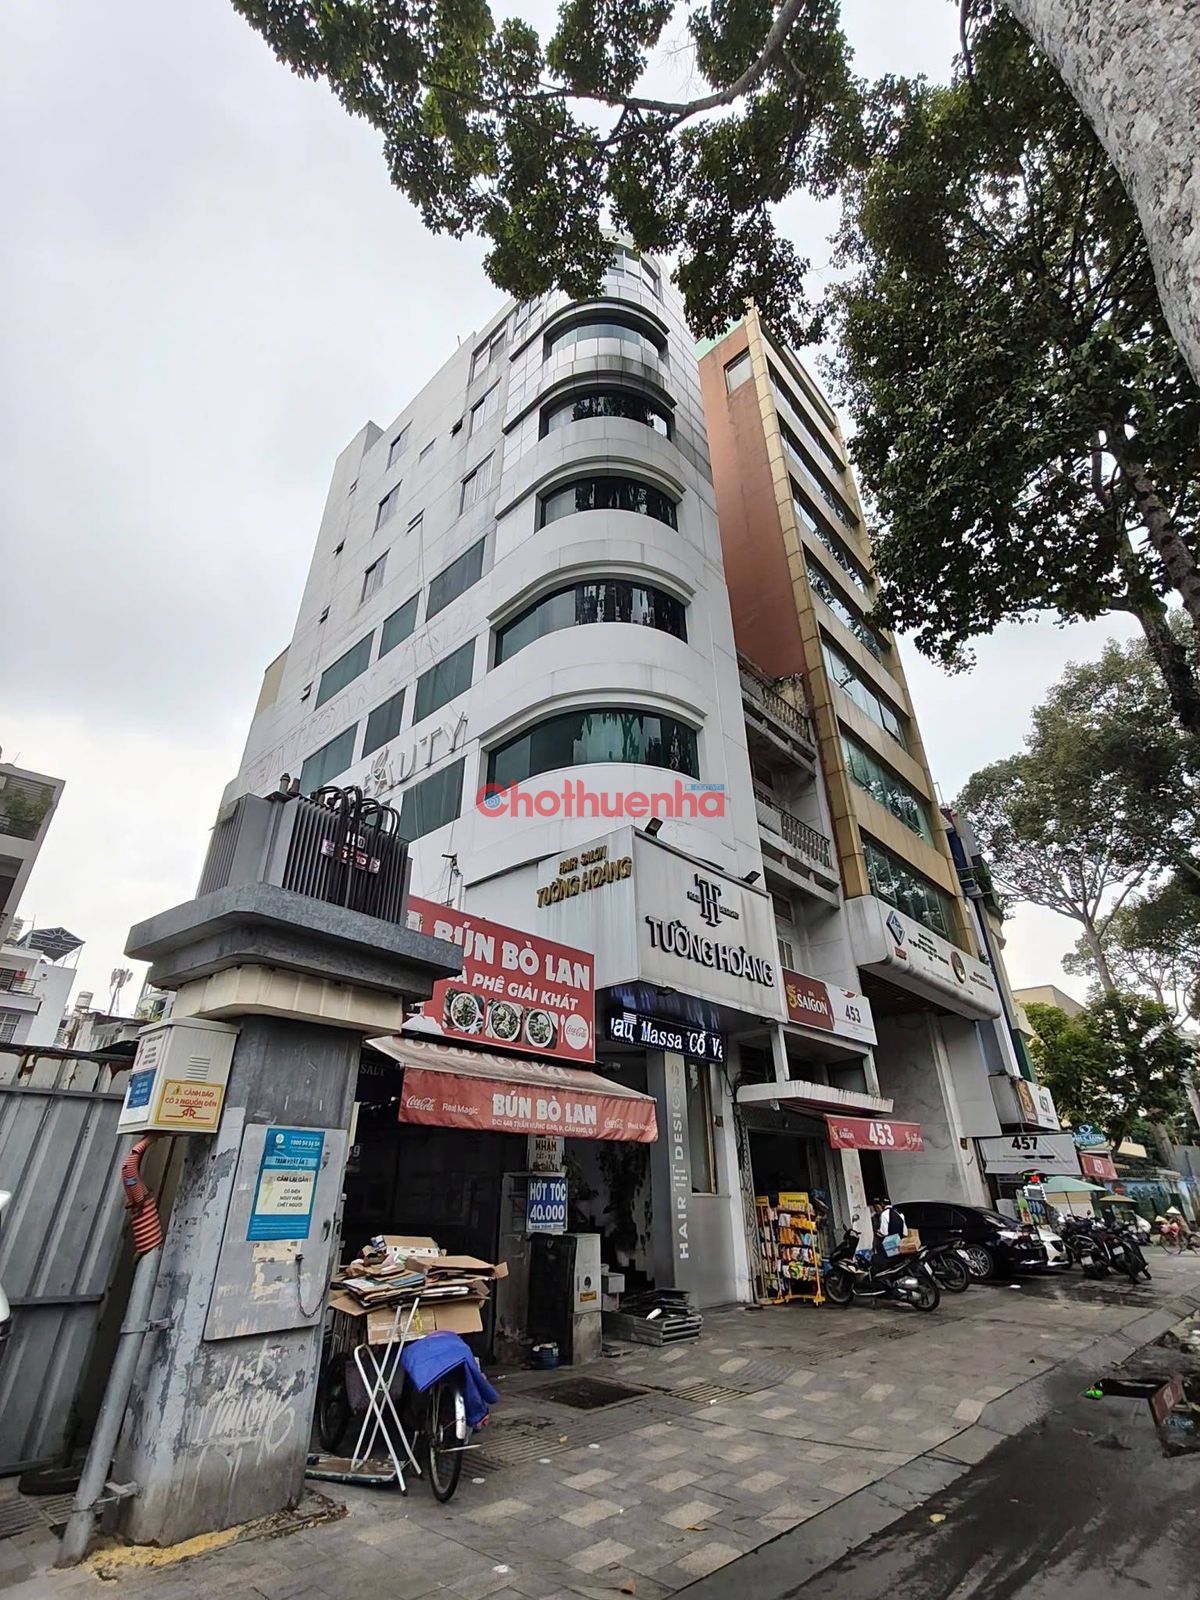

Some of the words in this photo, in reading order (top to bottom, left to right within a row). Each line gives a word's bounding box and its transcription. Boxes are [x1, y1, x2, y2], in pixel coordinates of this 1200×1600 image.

[581, 856, 632, 892] HOÀNG
[502, 940, 540, 976] BÒ
[545, 953, 590, 992] LAN
[645, 915, 714, 968] TƯỜNG
[714, 943, 774, 987] HOÀNG
[471, 972, 505, 993] PHÊ
[507, 981, 539, 1001] GIẢI
[540, 992, 579, 1011] KHÁT
[796, 993, 829, 1016] SAIGON
[845, 1004, 862, 1024] 453
[641, 1020, 683, 1050] Massa
[442, 1103, 456, 1112] Real
[492, 1090, 532, 1119] BÚN
[536, 1095, 562, 1122] BÒ
[565, 1103, 597, 1125] LAN
[869, 1122, 895, 1146] 453
[1011, 1136, 1038, 1151] 457
[530, 1180, 548, 1201] HỚT
[550, 1180, 567, 1201] TÓC
[530, 1204, 565, 1221] 40.000
[677, 1196, 690, 1260] HAIR
